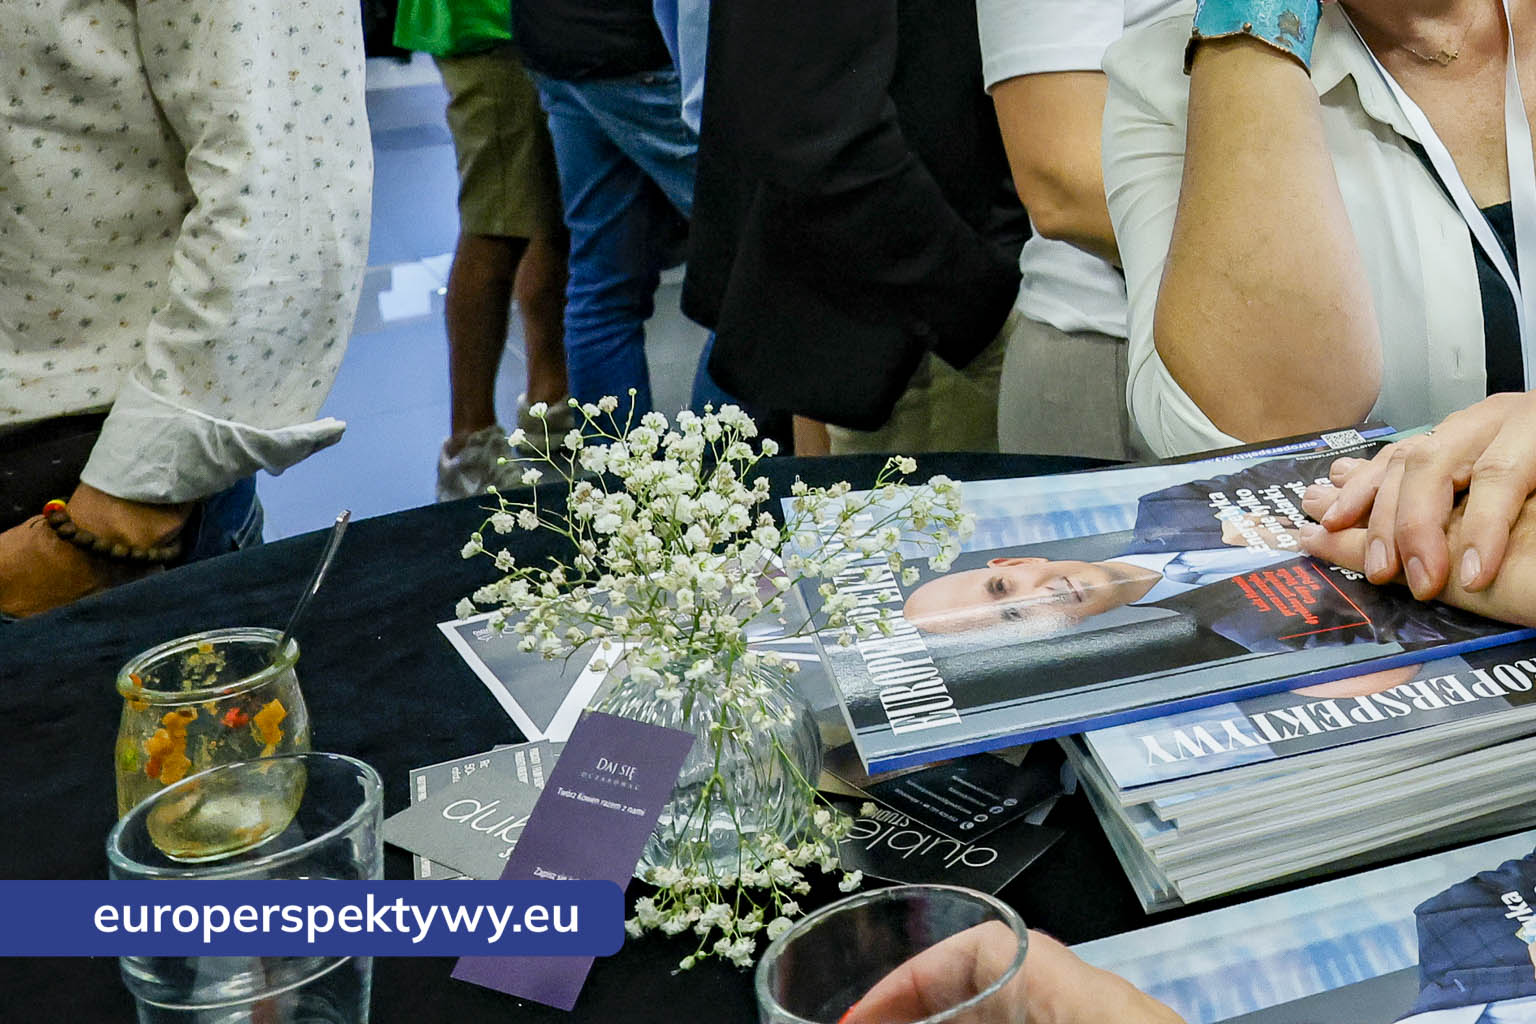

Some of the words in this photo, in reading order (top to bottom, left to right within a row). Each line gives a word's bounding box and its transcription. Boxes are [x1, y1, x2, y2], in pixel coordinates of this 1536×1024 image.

[1258, 484, 1309, 528] podarki,
[596, 757, 619, 775] DAJ
[870, 809, 910, 827] STUDI
